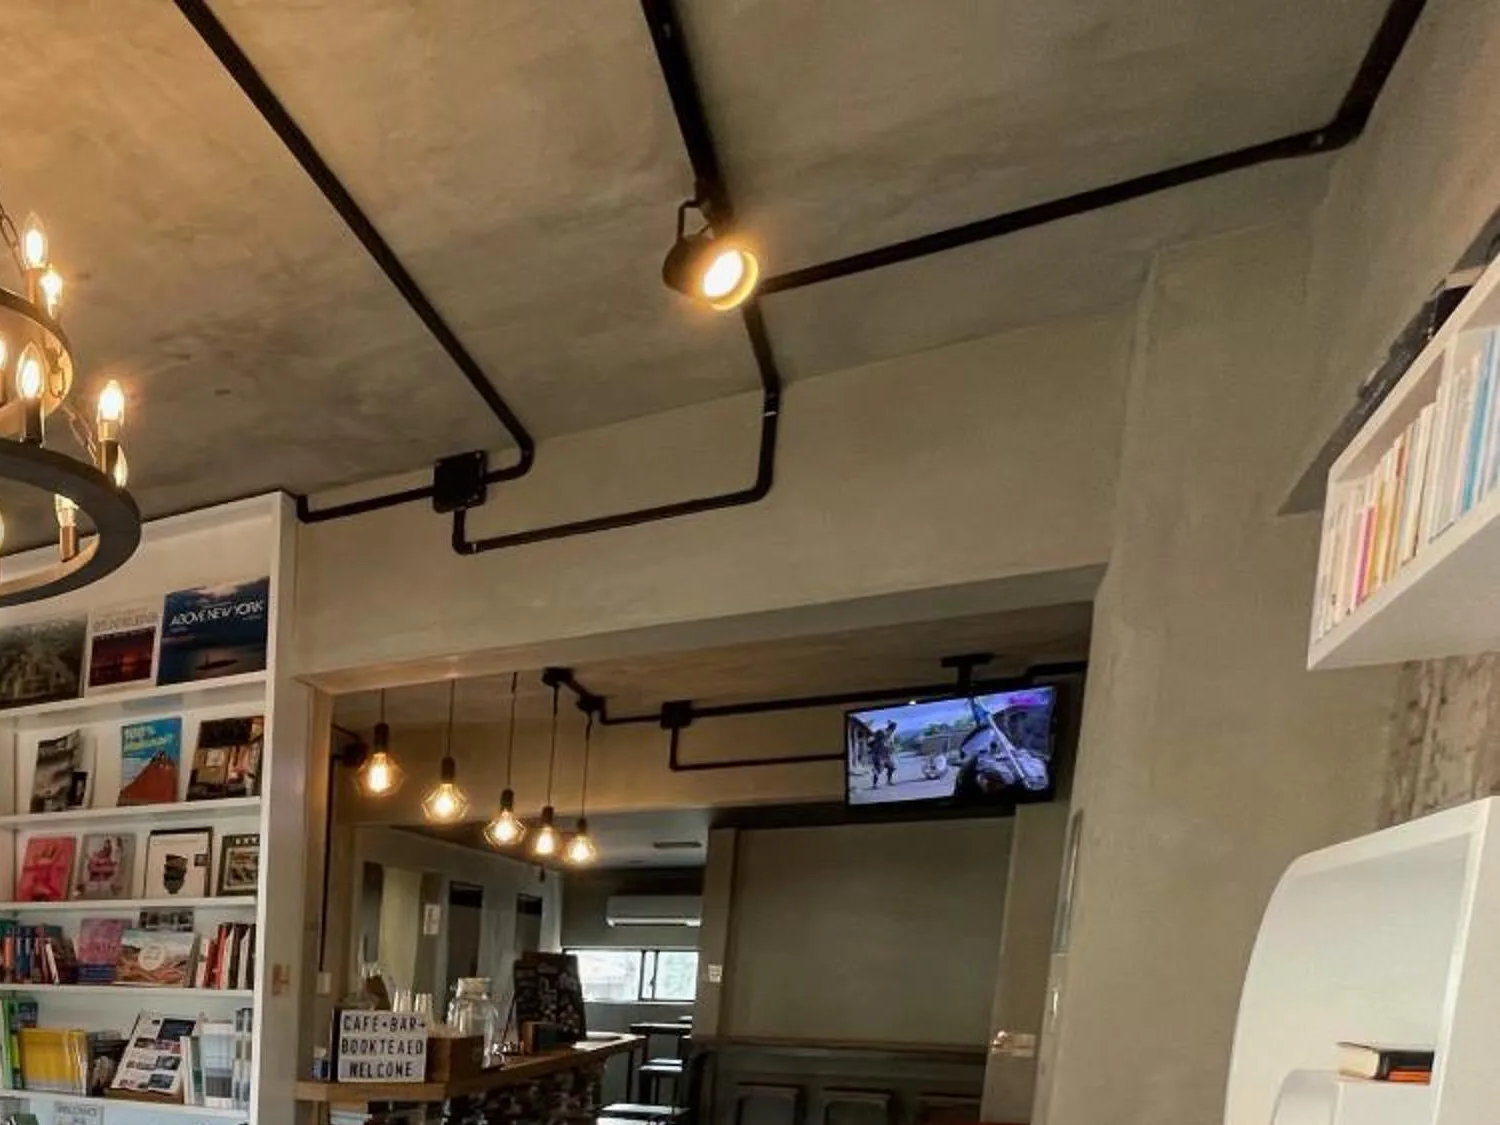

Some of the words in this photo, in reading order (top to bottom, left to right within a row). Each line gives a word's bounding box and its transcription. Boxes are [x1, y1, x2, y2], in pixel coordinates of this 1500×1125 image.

[208, 606, 232, 620] NEW
[234, 599, 264, 616] YORK
[349, 1061, 414, 1078] WELCOME
